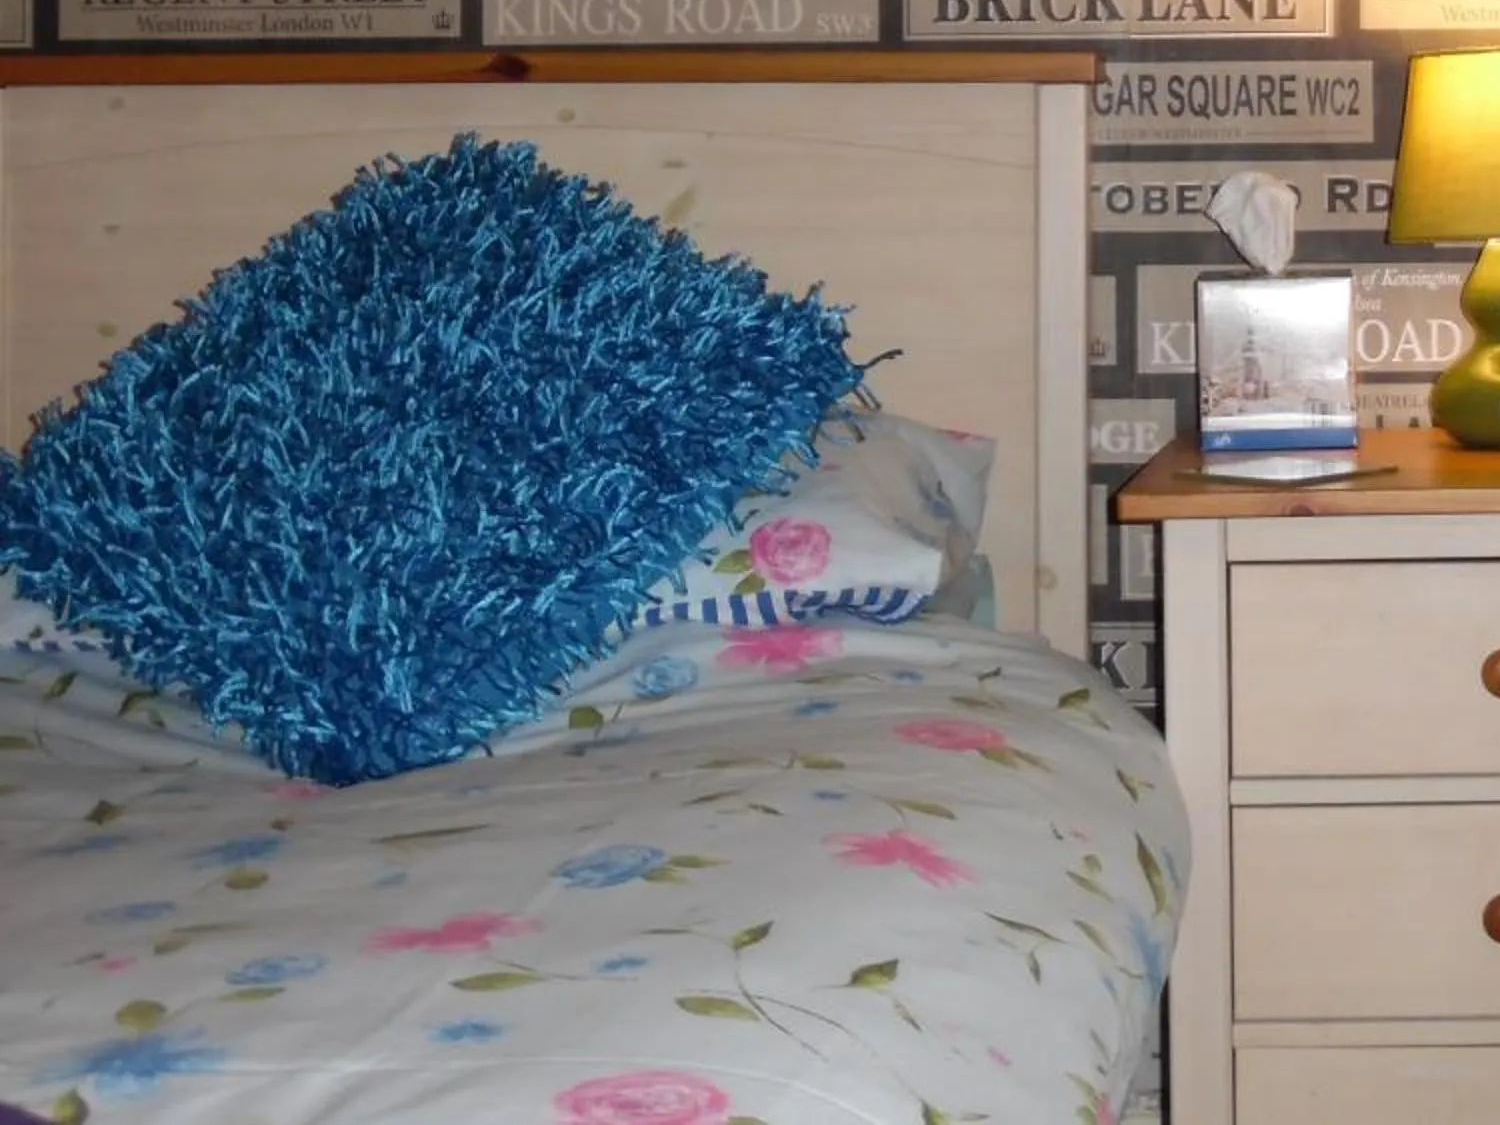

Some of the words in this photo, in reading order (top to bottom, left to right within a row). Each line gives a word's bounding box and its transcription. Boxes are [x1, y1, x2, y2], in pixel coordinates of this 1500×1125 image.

[136, 13, 254, 33] Westminster
[260, 12, 333, 33] London
[1167, 74, 1297, 120] SQUARE
[1306, 78, 1360, 116] WC2
